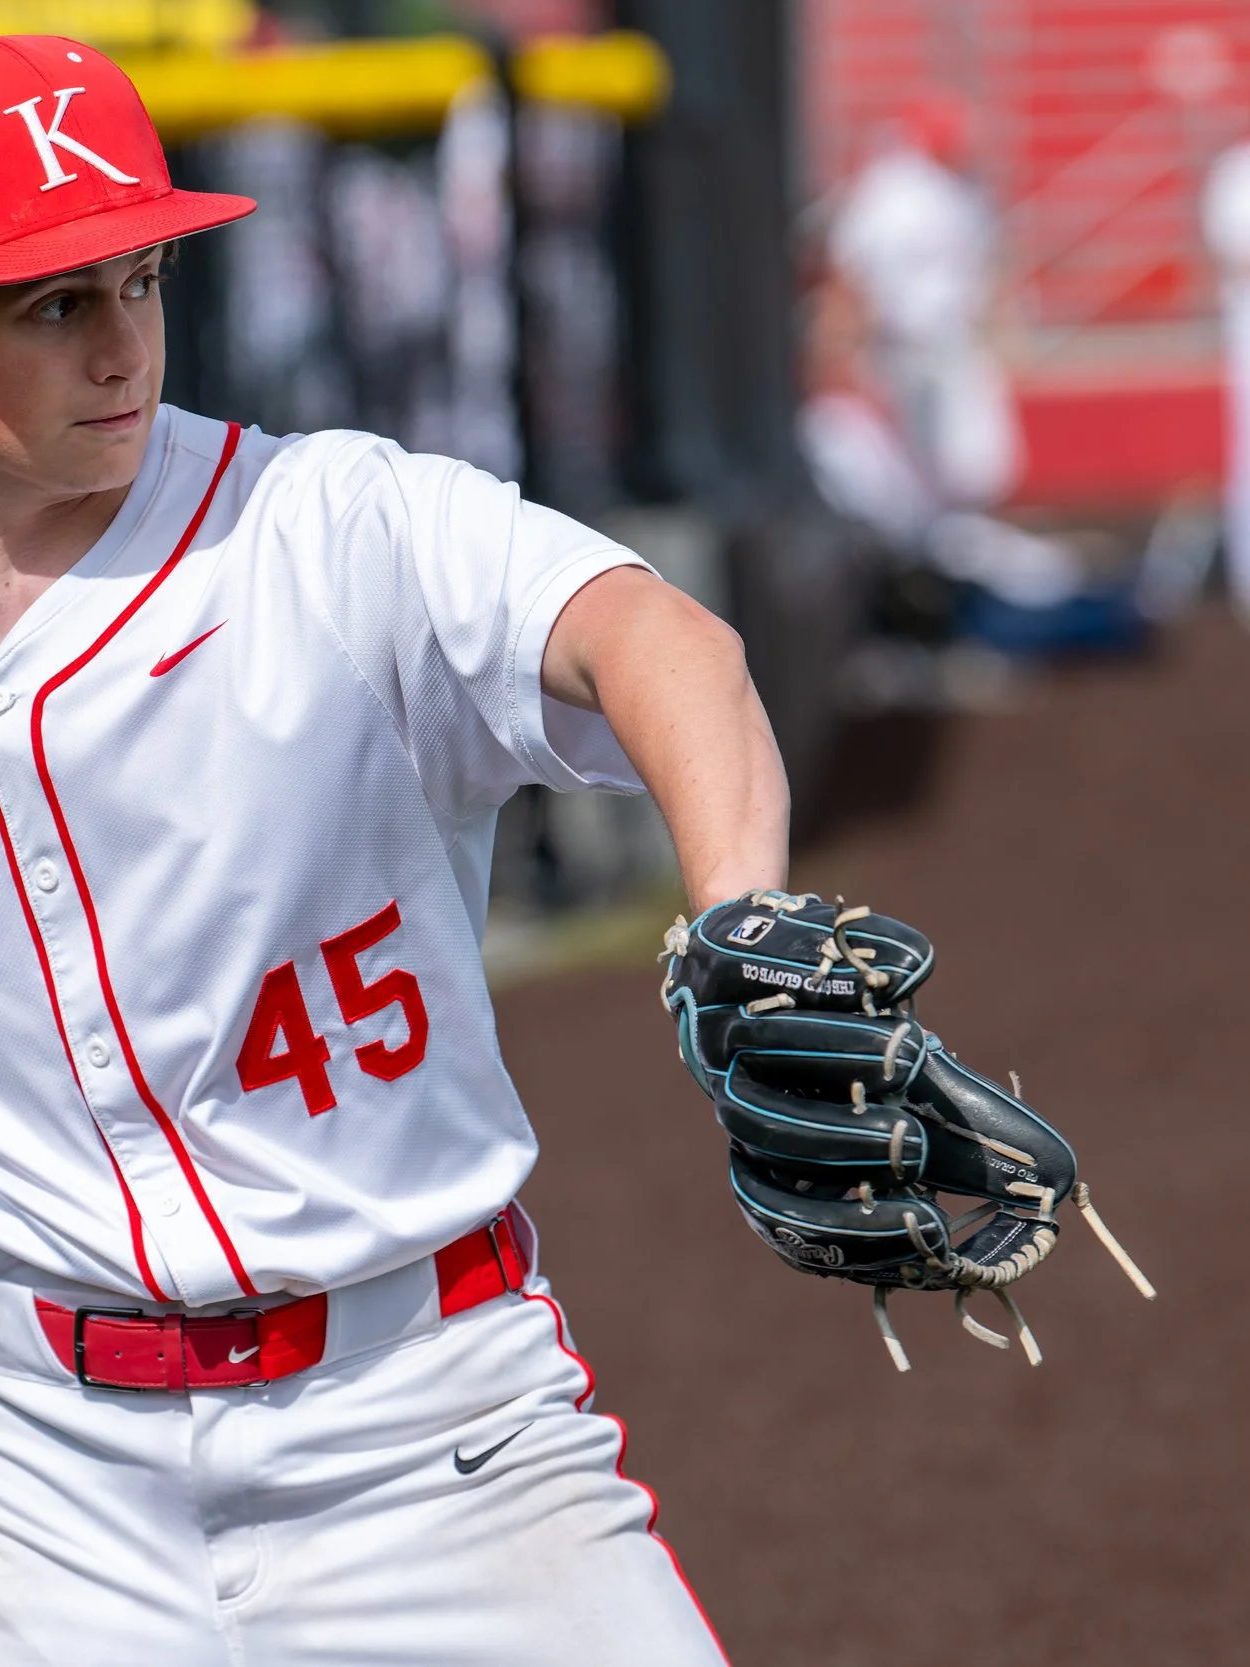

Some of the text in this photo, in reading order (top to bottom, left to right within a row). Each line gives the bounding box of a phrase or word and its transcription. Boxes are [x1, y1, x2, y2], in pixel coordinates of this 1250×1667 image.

[3, 87, 140, 192] K
[759, 967, 802, 990] GLOVE
[803, 977, 831, 995] GD
[832, 980, 856, 995] THE
[236, 899, 429, 1117] 45
[1017, 1169, 1039, 1183] PRO
